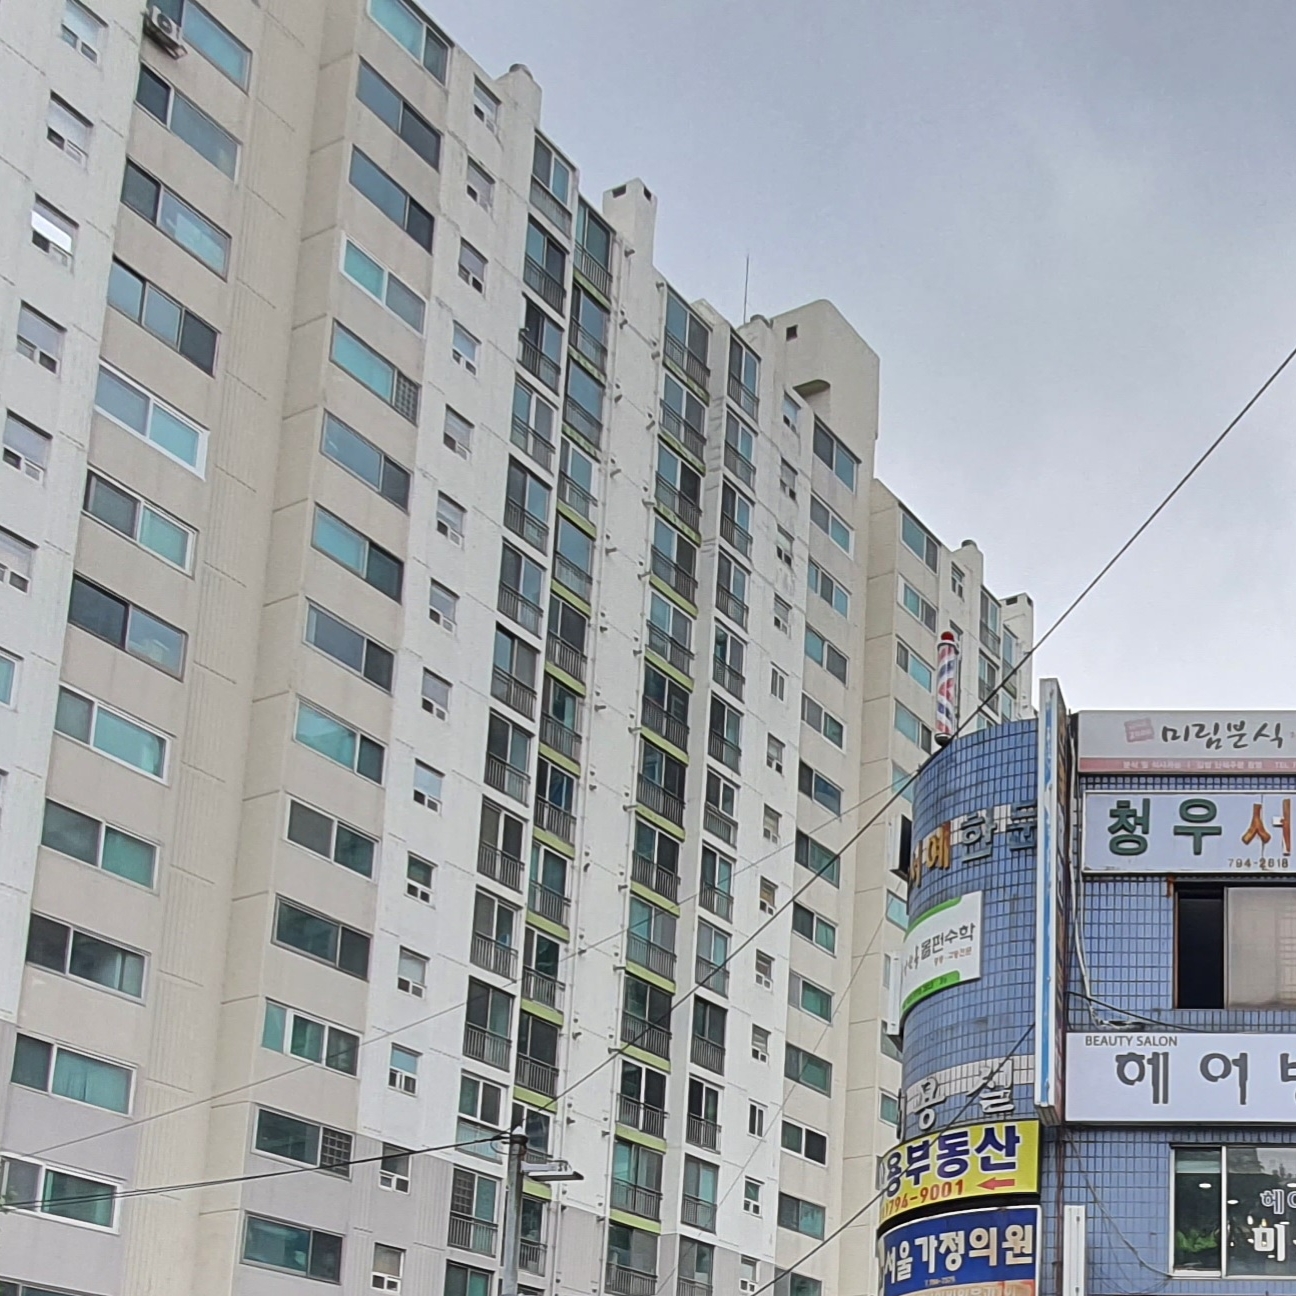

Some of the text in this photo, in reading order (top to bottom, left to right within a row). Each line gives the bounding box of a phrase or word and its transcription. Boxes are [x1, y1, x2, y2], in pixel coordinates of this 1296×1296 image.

[1161, 720, 1284, 750] 미림분식
[1085, 1036, 1178, 1047] BEAUTY SALON
